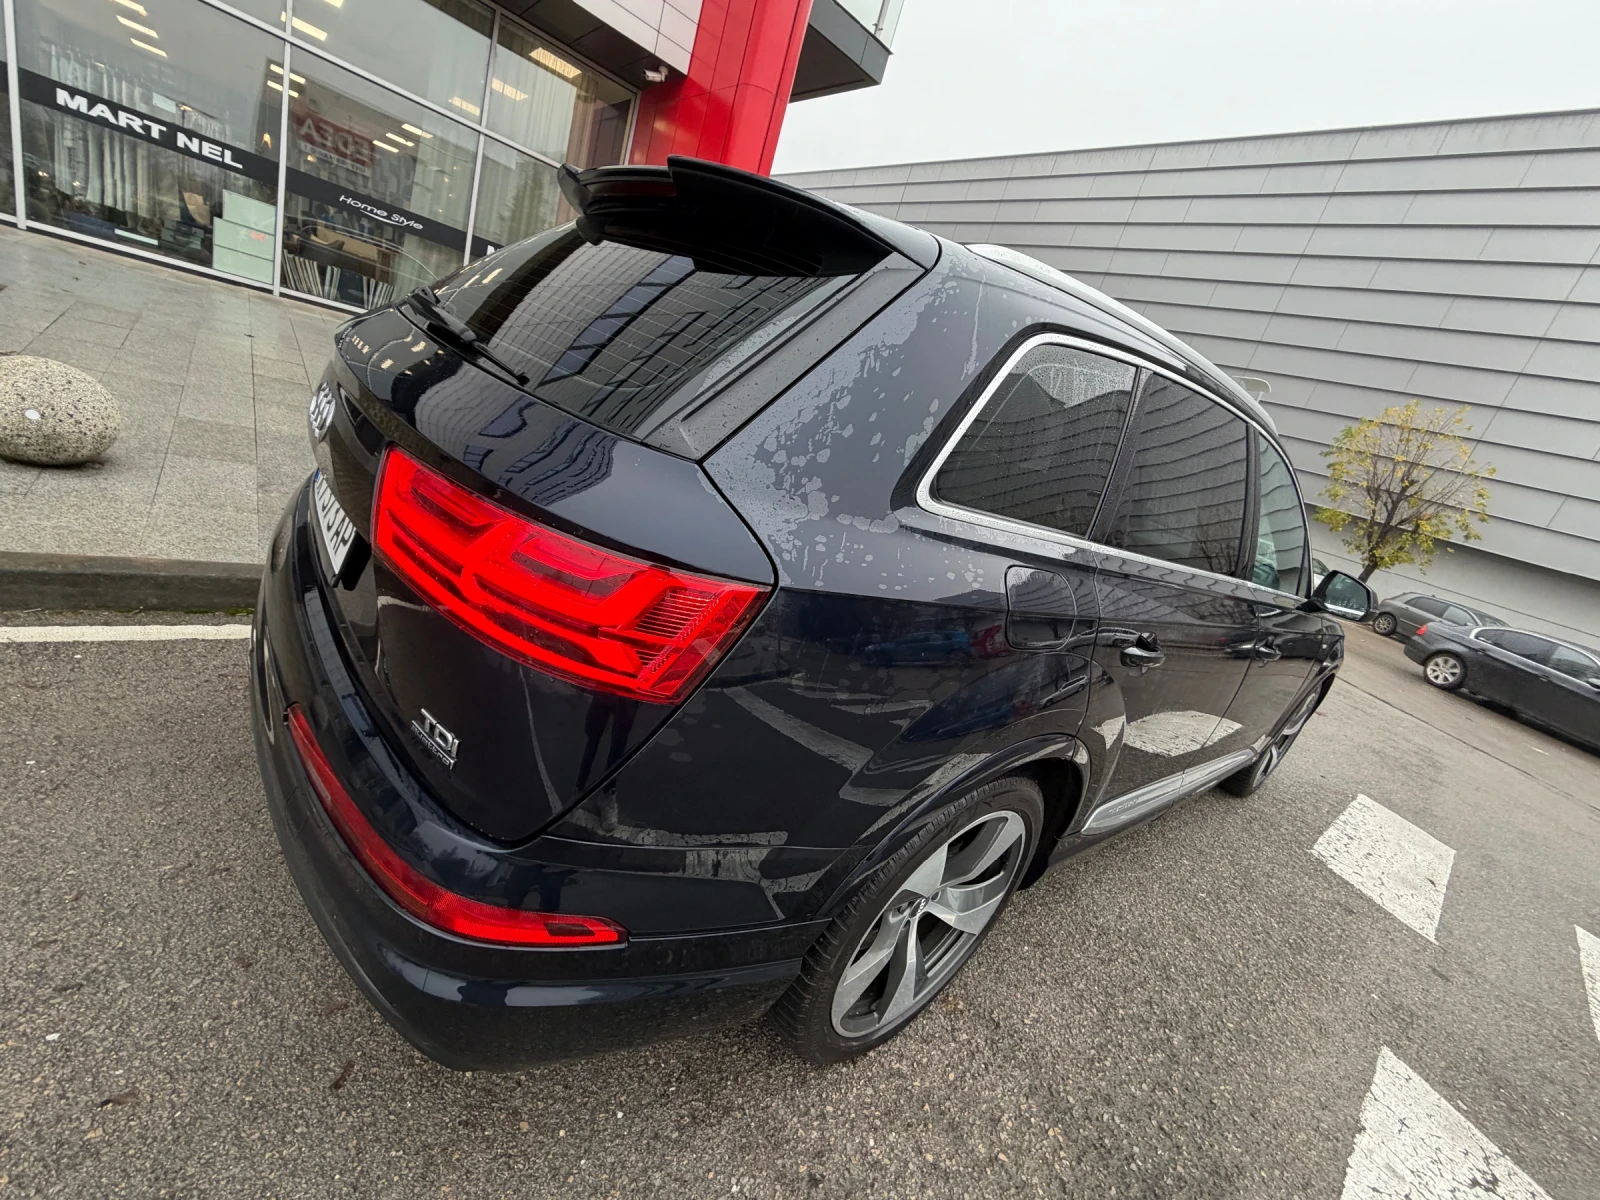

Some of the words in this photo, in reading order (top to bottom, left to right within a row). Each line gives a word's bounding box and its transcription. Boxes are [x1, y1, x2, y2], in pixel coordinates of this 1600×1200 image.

[55, 87, 168, 140] MART
[176, 131, 244, 170] NEL
[338, 194, 389, 217] Home
[390, 213, 424, 231] Style
[410, 724, 450, 766] quattro
[420, 707, 460, 758] TDI
